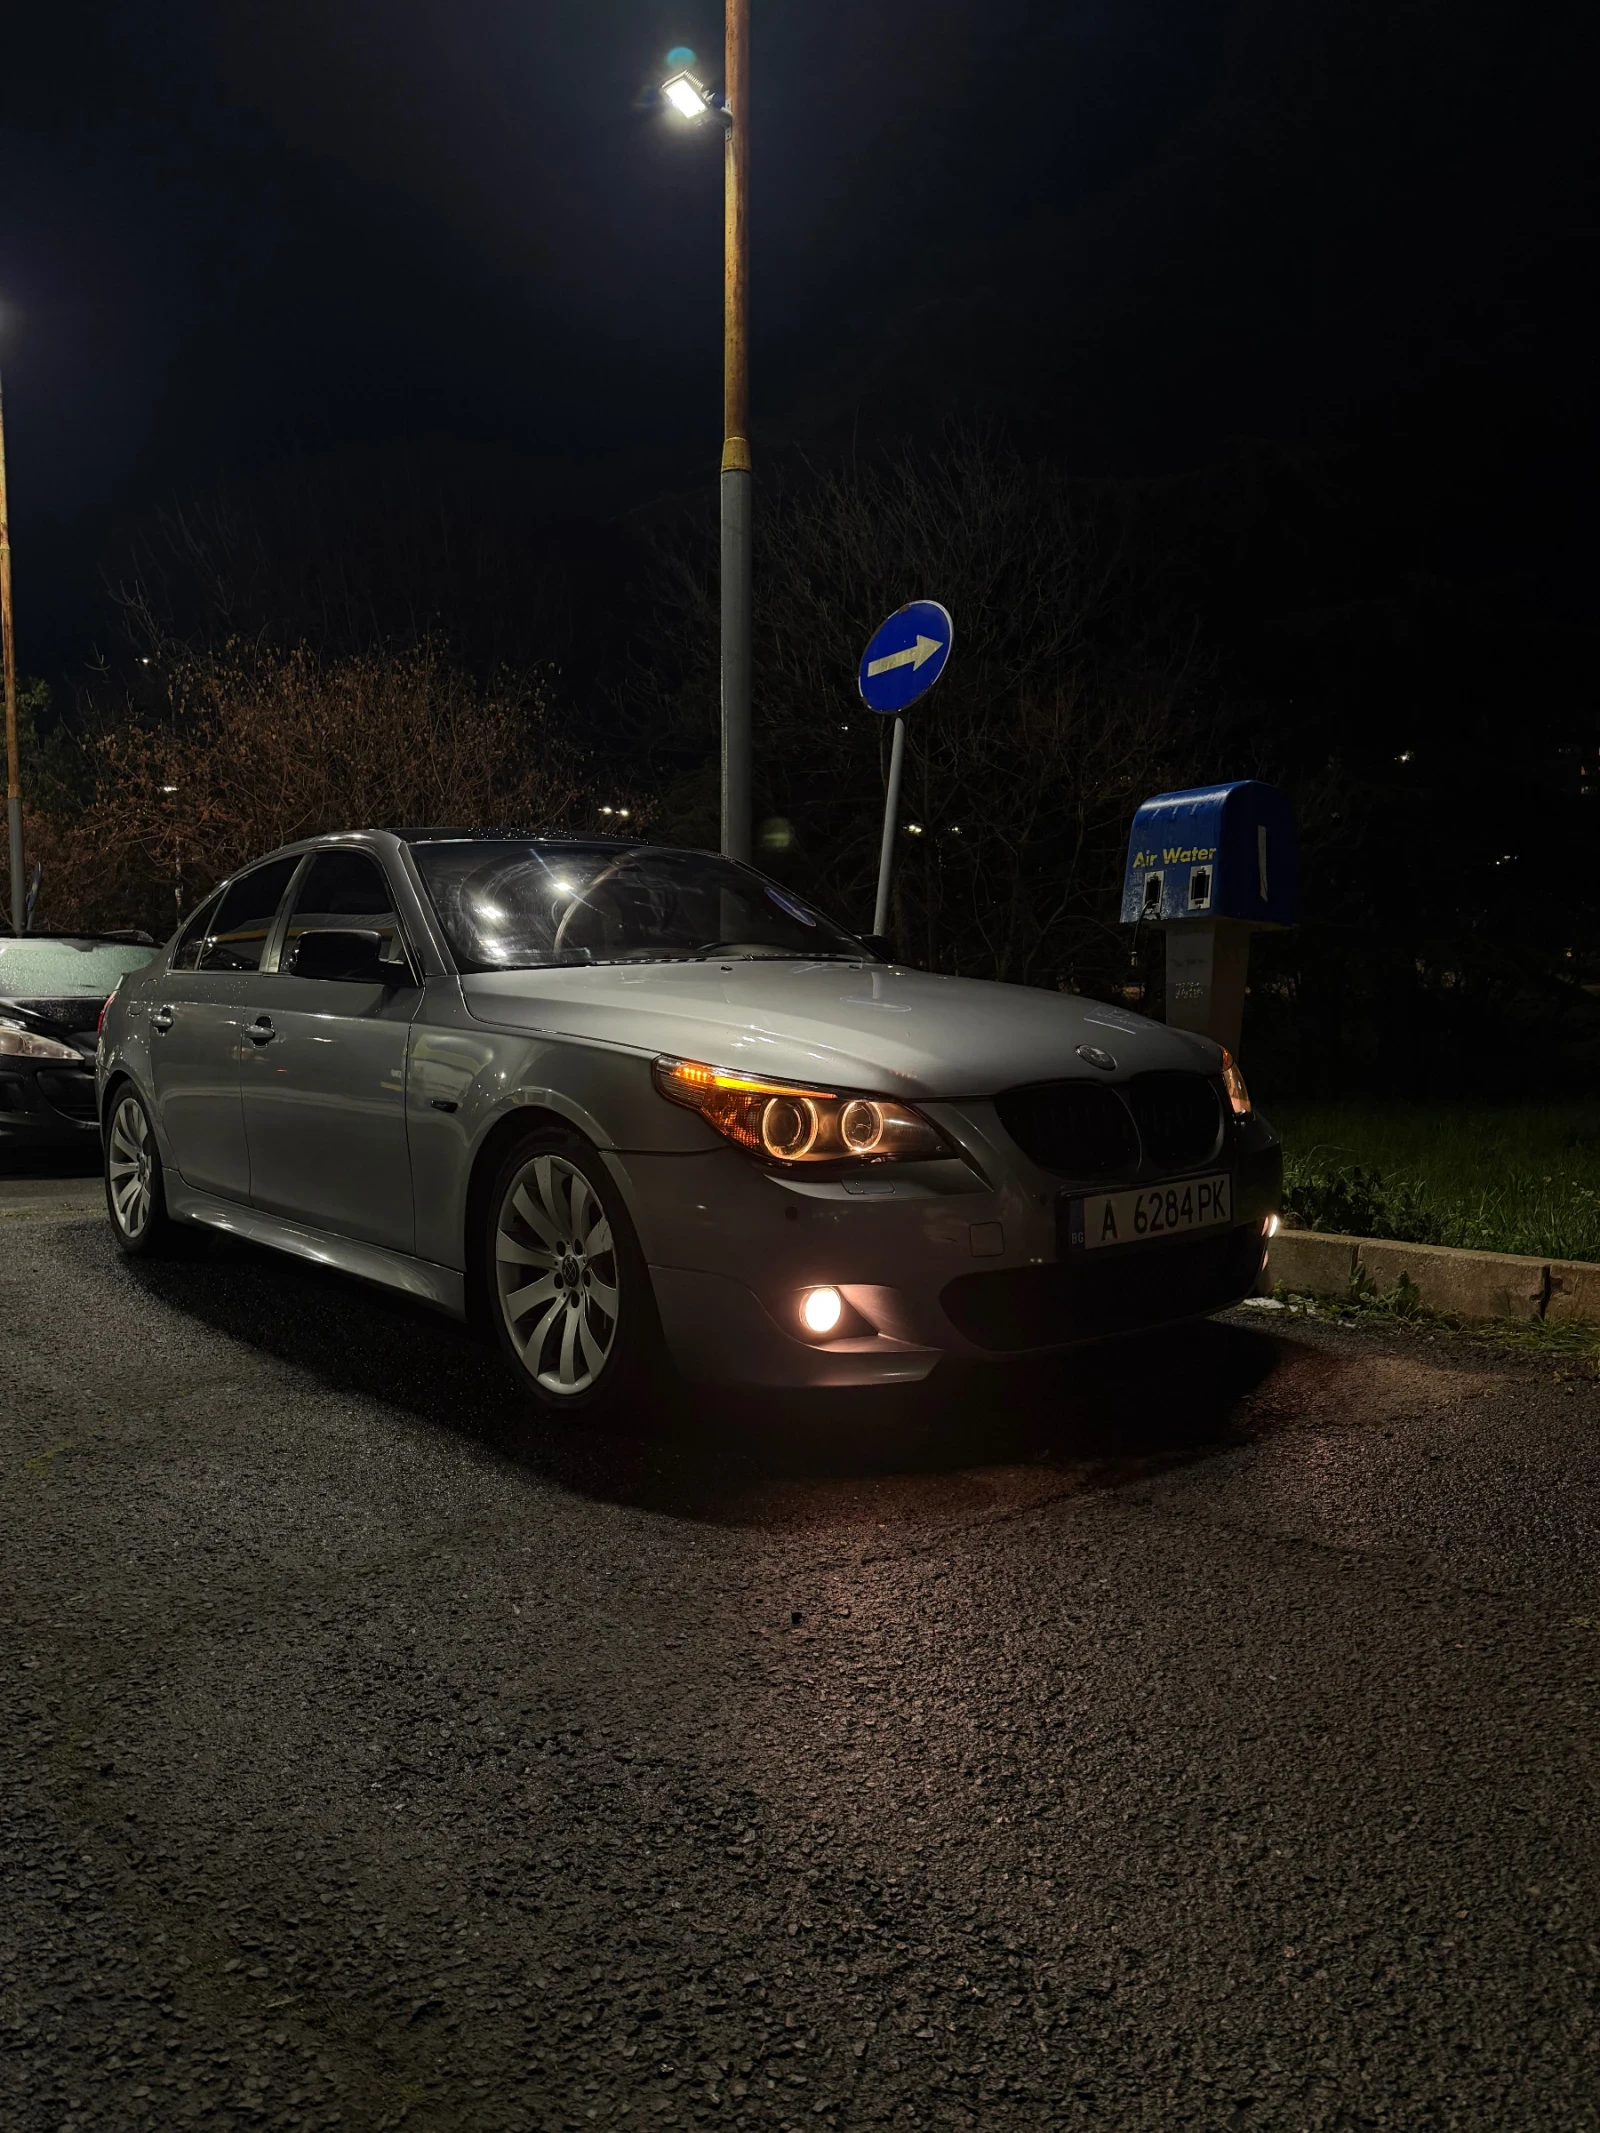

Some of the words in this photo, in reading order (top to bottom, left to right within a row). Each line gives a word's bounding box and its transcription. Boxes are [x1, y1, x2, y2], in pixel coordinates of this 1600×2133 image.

[1132, 850, 1158, 868] Air
[1162, 847, 1217, 865] Water
[1101, 1200, 1118, 1241] A
[1072, 1232, 1084, 1244] BG
